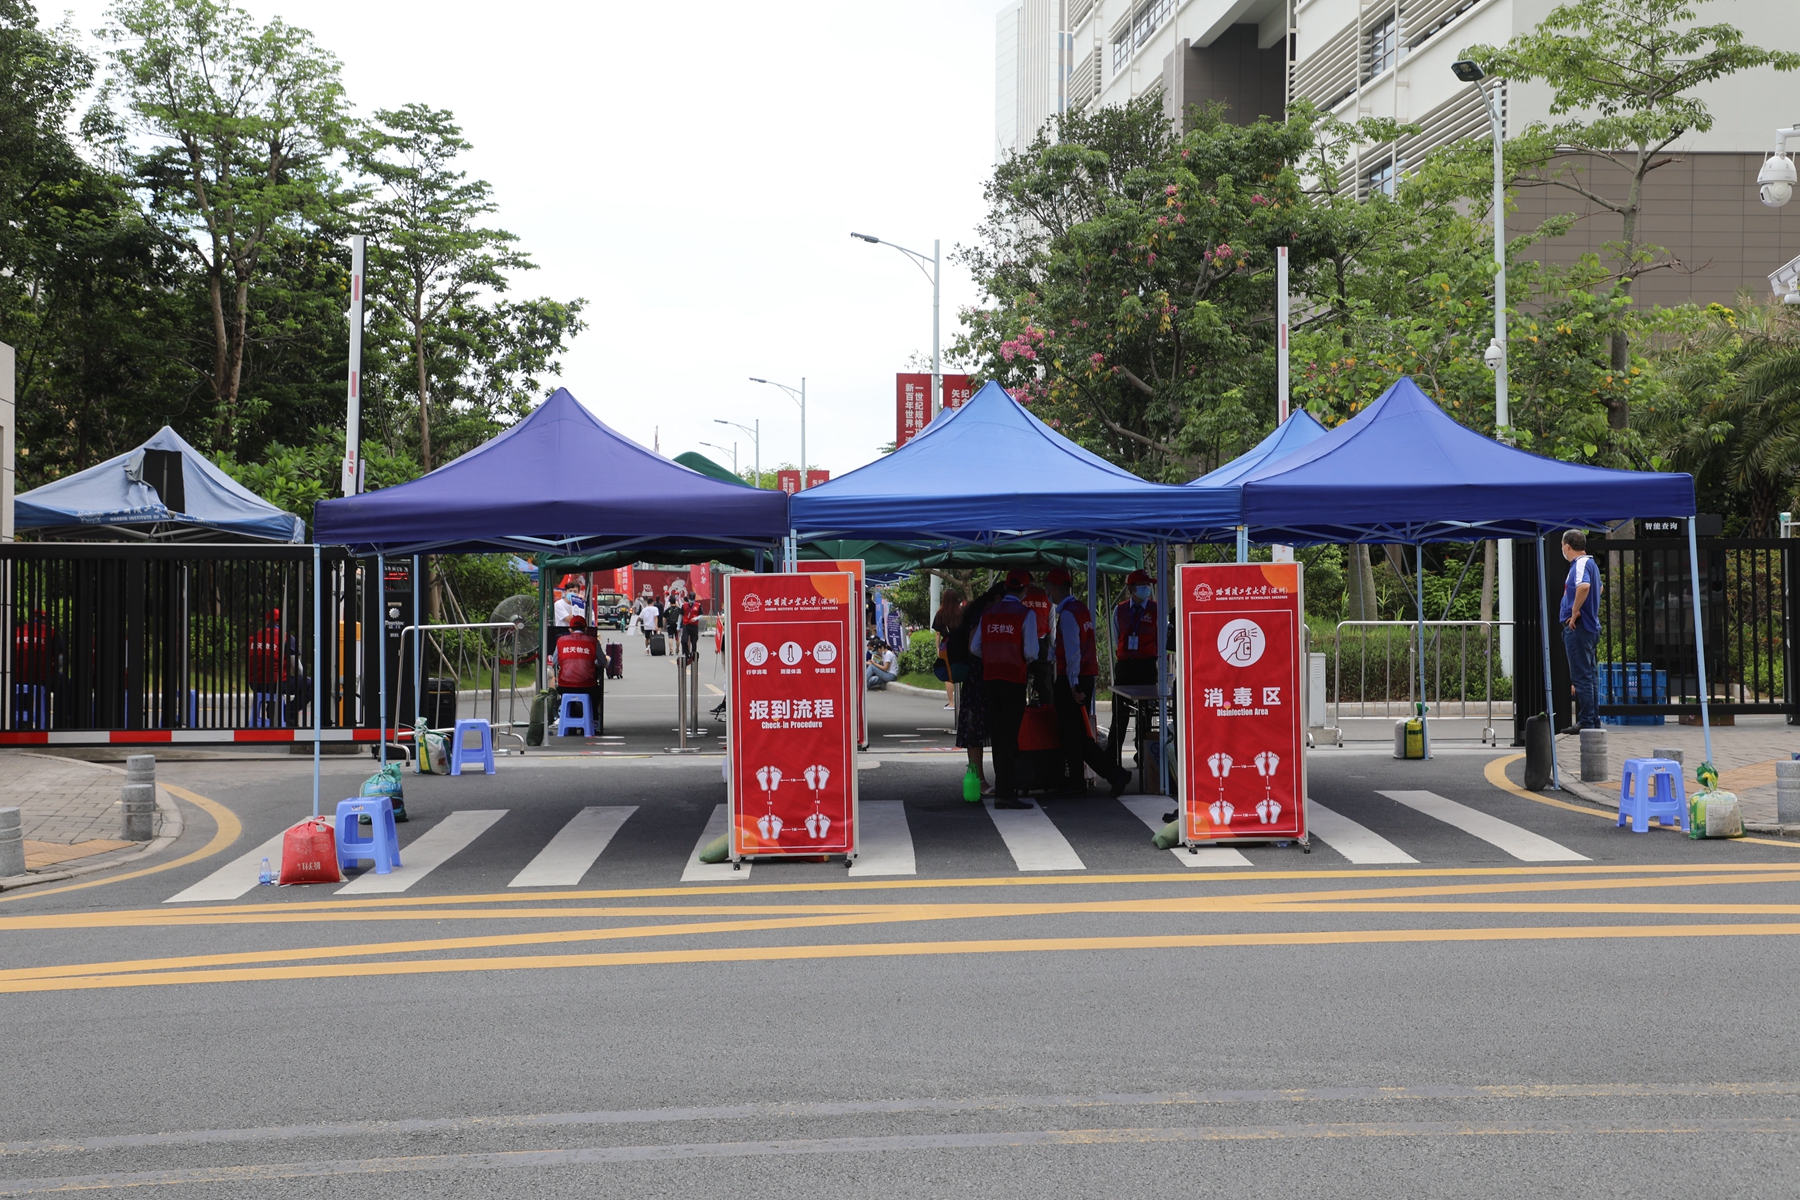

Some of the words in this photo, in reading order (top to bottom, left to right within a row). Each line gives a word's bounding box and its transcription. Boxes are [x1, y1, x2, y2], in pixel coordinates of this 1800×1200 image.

[1645, 522, 1678, 530] 智能查询
[563, 646, 590, 655] 航天物业
[749, 699, 834, 720] 报到流程
[1217, 708, 1253, 717] Disinfection
[790, 720, 823, 728] Procedure
